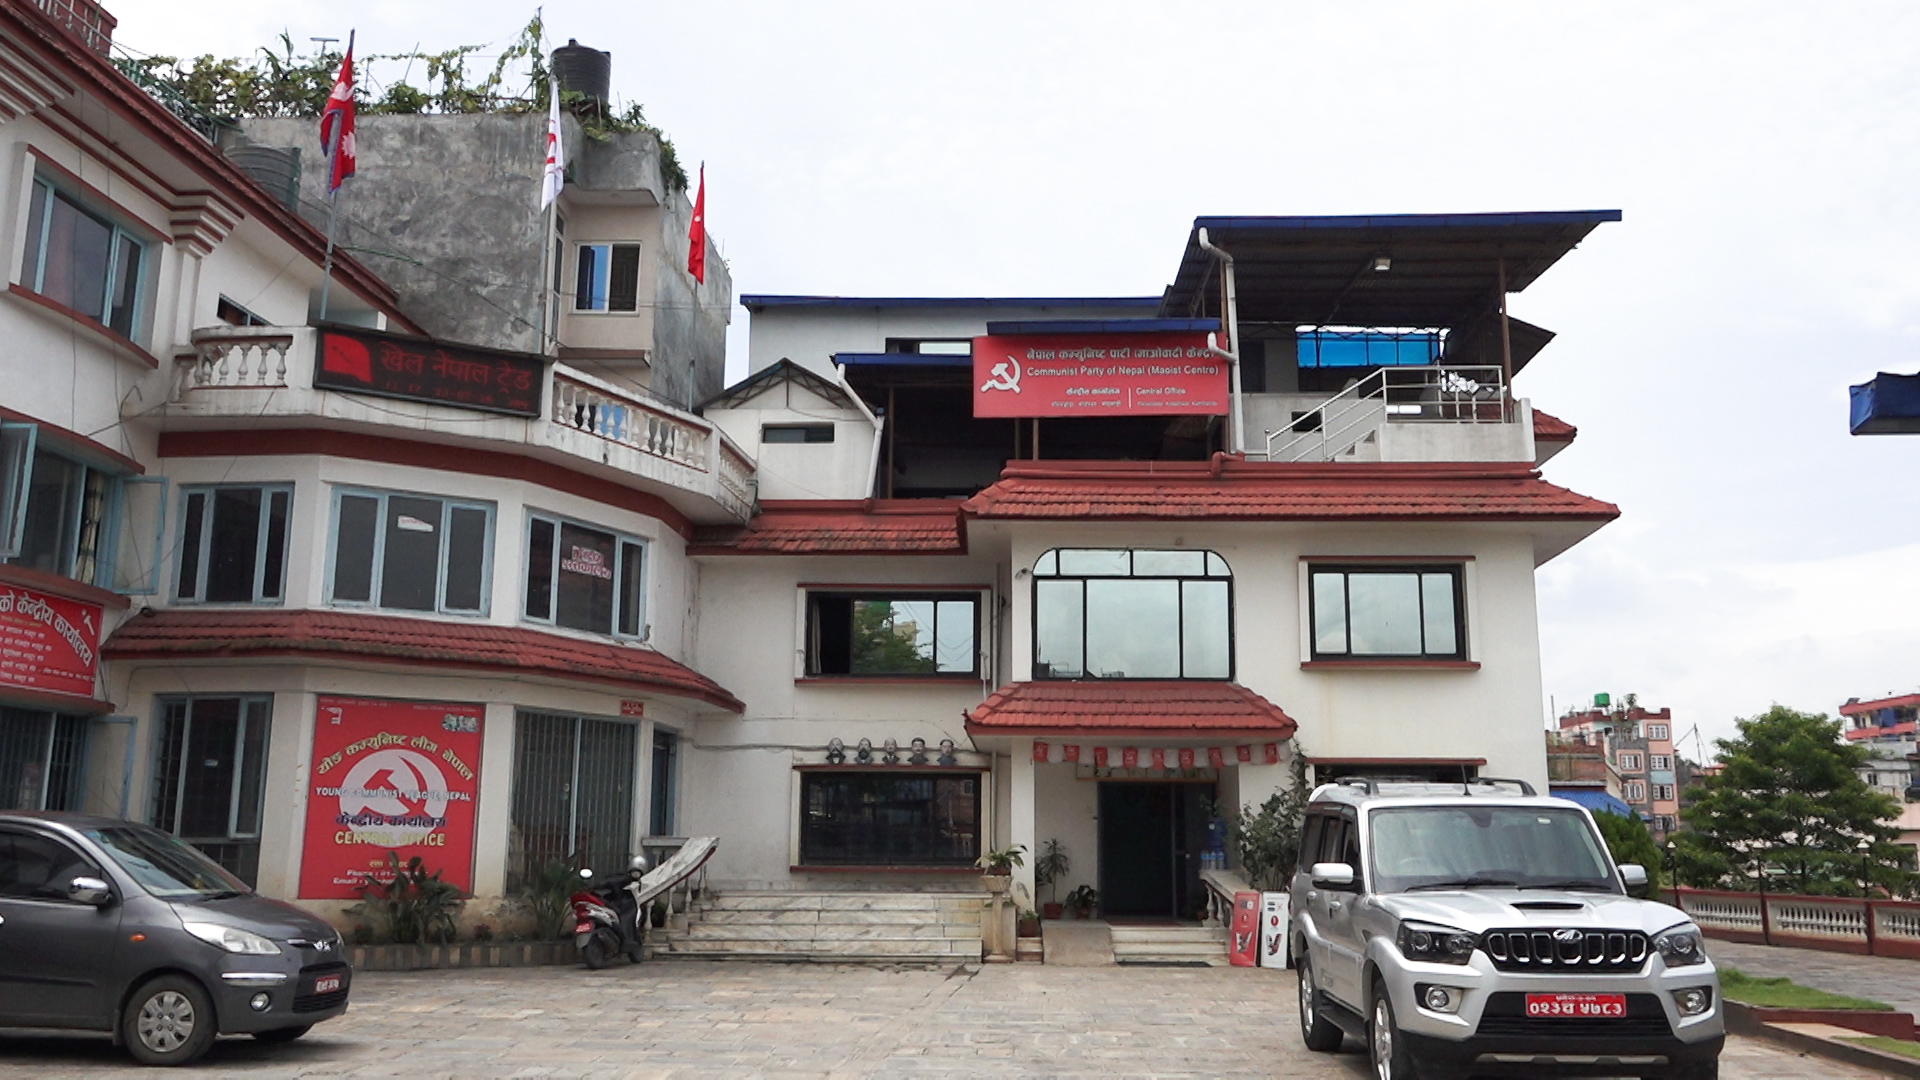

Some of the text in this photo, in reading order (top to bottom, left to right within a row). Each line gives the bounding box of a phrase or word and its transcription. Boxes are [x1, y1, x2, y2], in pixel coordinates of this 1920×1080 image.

[1027, 347, 1055, 360] नेपाल
[430, 350, 491, 385] नेपाल
[1027, 365, 1219, 378] Communist Party of Nepal (Maoist Centre)
[1136, 387, 1186, 395] Central Office
[442, 748, 474, 781] नेपाल
[316, 786, 346, 797] YOUNG
[350, 787, 402, 799] COMMUNIST
[443, 790, 471, 802] NEPAL
[335, 831, 446, 846] CENTRAL OFFICE
